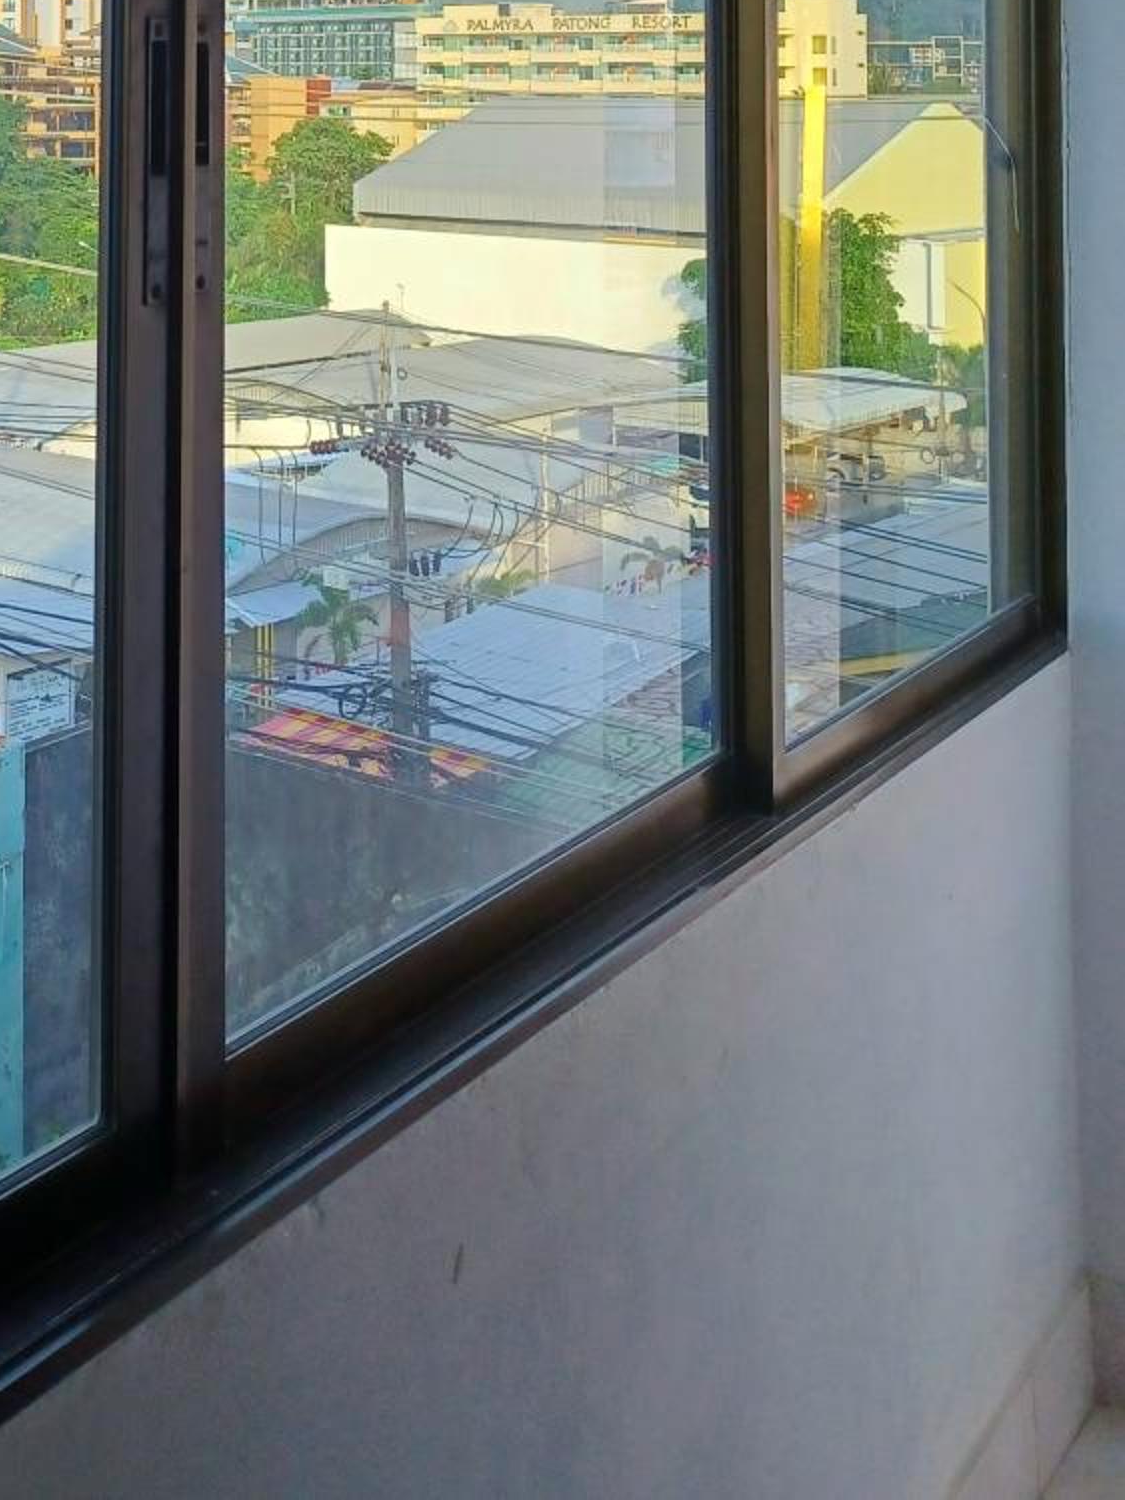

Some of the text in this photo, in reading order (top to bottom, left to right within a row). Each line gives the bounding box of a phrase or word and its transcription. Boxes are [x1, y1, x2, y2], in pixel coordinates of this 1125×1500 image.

[466, 15, 692, 32] PALMYRA PATONG RESORT
